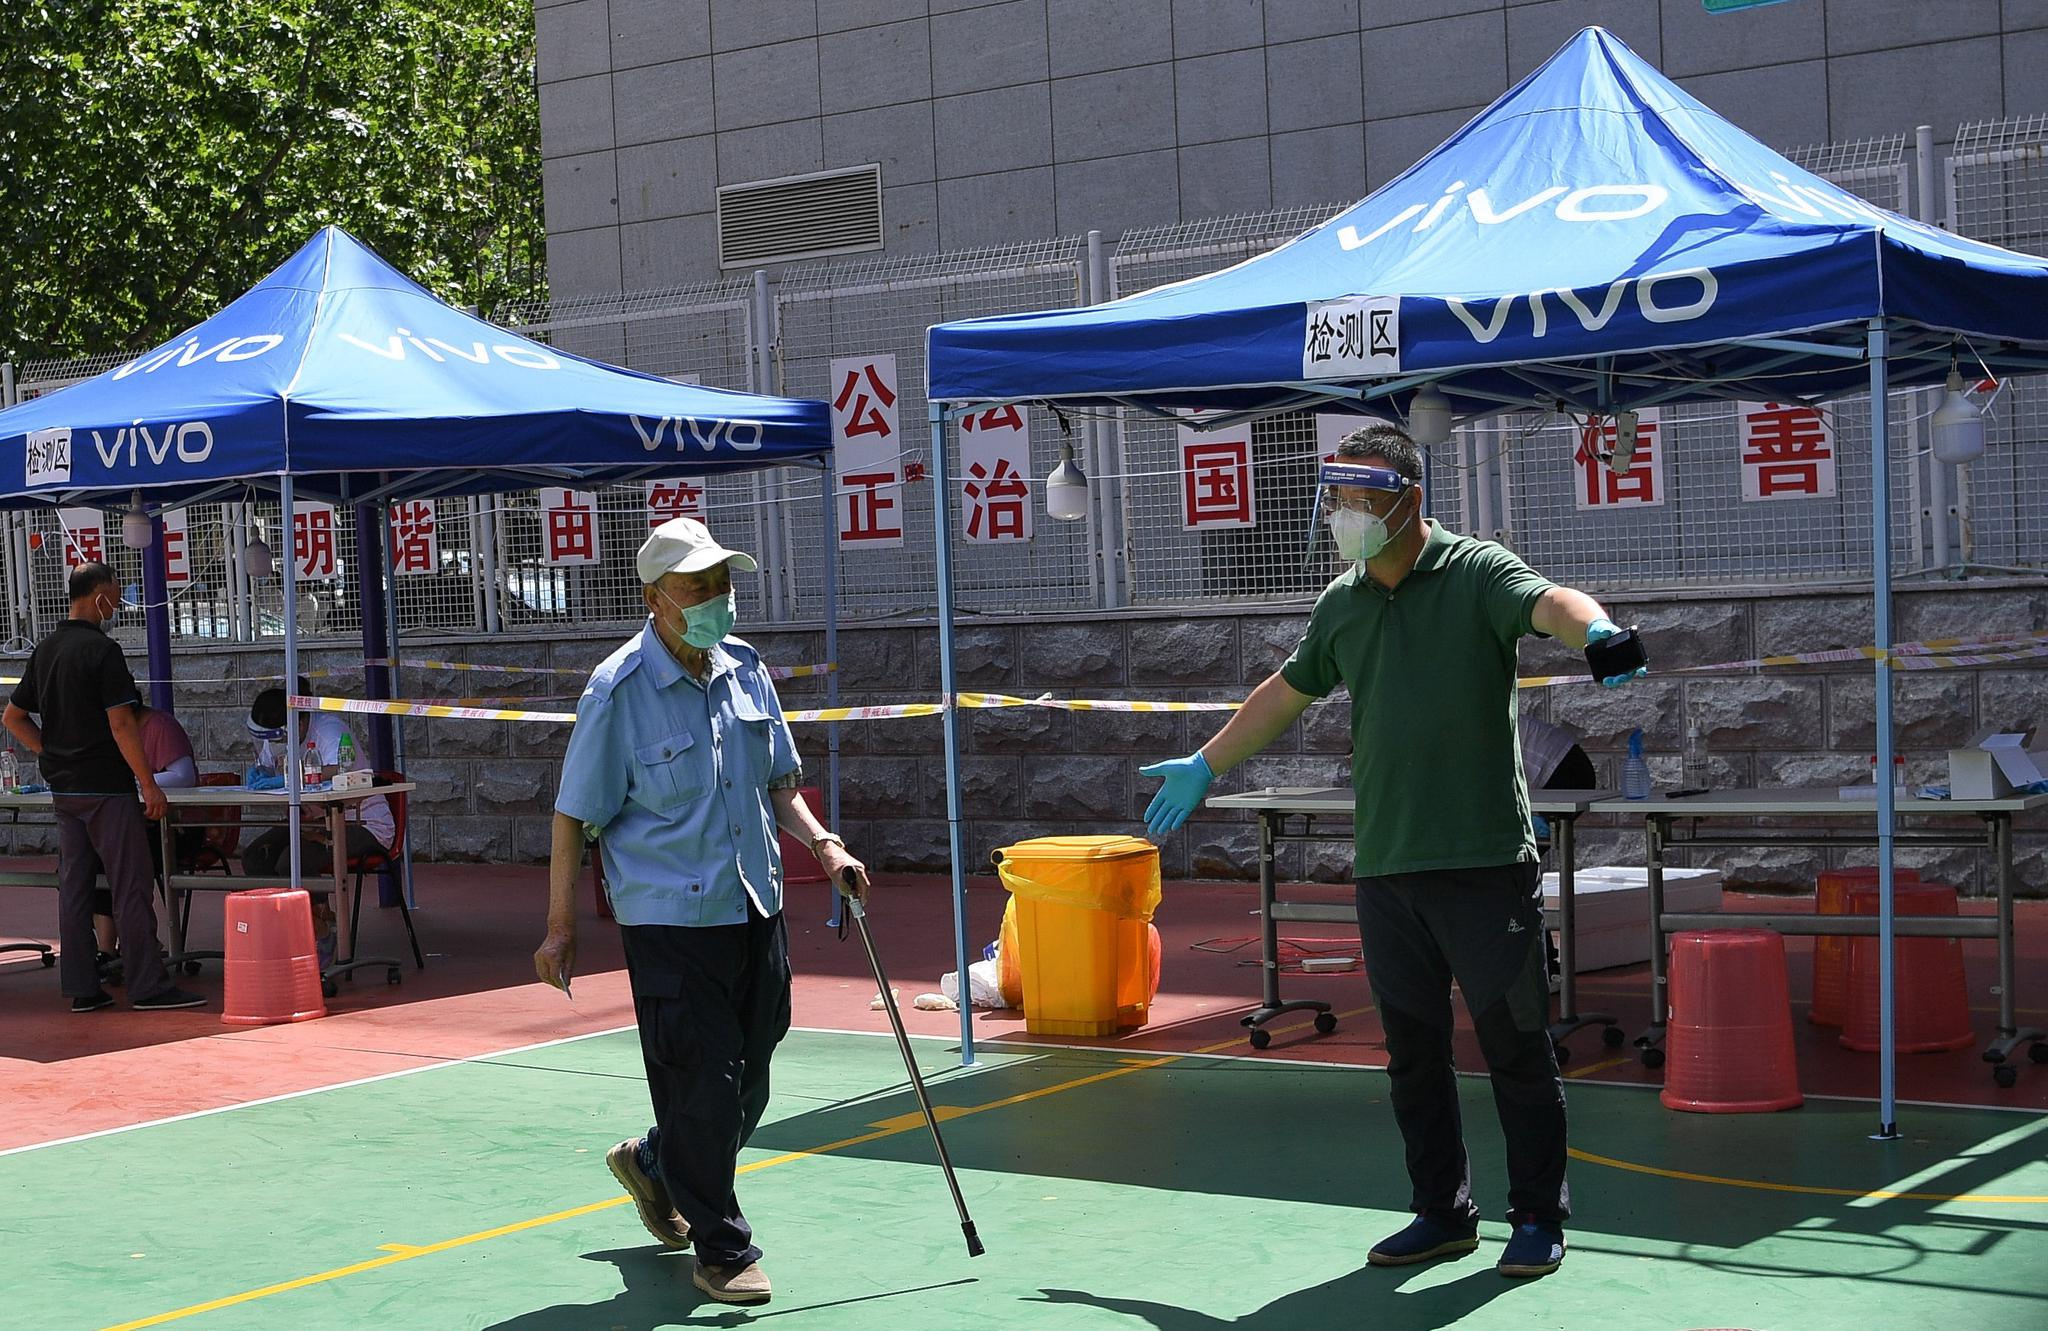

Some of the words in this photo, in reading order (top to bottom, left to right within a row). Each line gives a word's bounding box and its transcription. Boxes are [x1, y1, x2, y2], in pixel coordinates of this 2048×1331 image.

[1336, 181, 1669, 251] vivo
[1307, 310, 1398, 364] 检测区
[1445, 267, 1718, 344] vivo
[112, 335, 284, 381] vivo
[337, 327, 561, 370] vivo
[27, 437, 70, 476] 检测区
[92, 418, 214, 469] vivo
[833, 364, 901, 541] 公正
[1743, 402, 1831, 497] 善
[1184, 442, 1250, 526] 国
[293, 510, 334, 577] 明
[549, 490, 593, 561] 由
